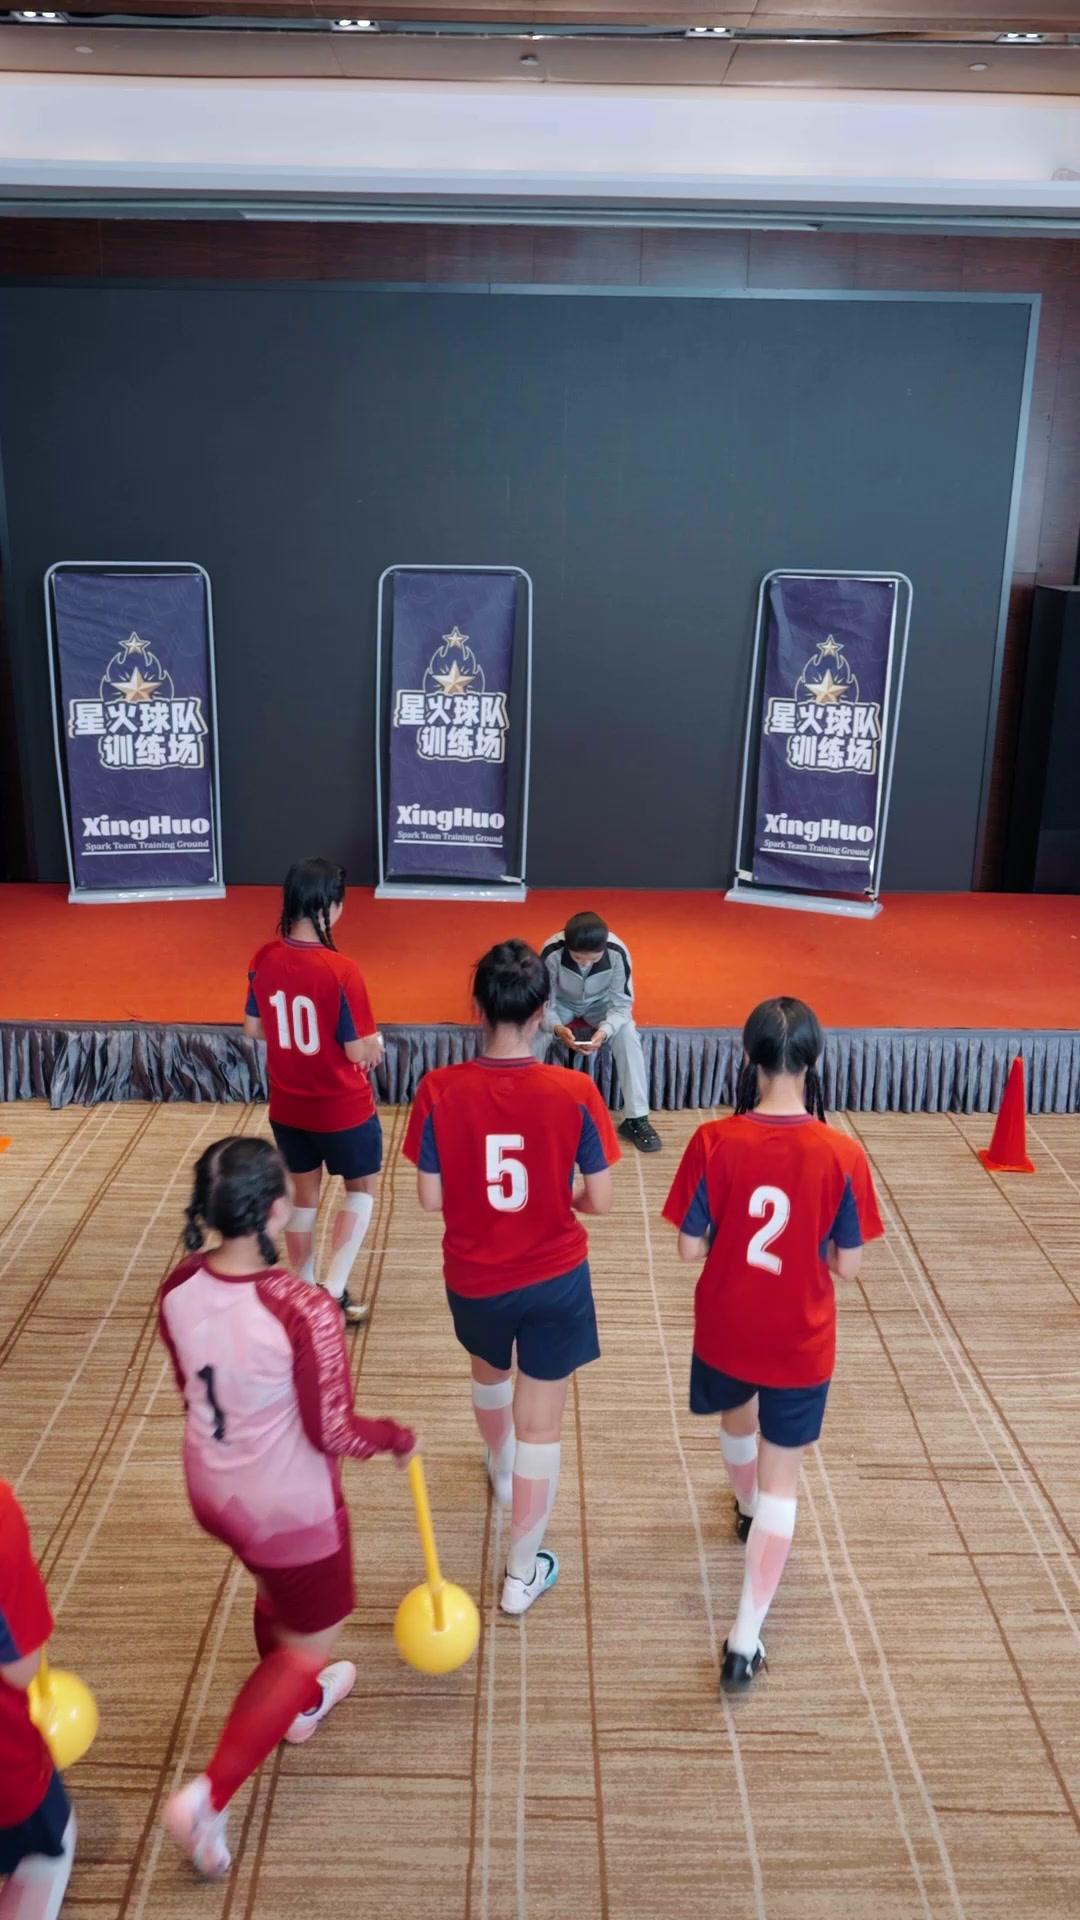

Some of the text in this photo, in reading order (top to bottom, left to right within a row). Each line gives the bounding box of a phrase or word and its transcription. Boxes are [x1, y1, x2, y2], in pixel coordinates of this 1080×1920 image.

[75, 702, 202, 735] 星火球队
[399, 693, 505, 728] 星火球队
[769, 701, 878, 739] 星火球队
[103, 734, 200, 766] 训练场
[421, 726, 501, 759] 训练场
[790, 735, 873, 770] 训练场
[82, 814, 210, 840] XingHuo
[396, 803, 505, 831] XingHuo
[763, 813, 874, 842] XingHuo
[85, 839, 209, 852] Spark Team Training Ground
[397, 830, 503, 844] Spark Team Training Ground
[763, 839, 871, 856] Spark Team Training Ground
[269, 989, 320, 1056] 10
[485, 1134, 528, 1213] 5
[747, 1185, 790, 1276] 2
[198, 1364, 226, 1441] 1
